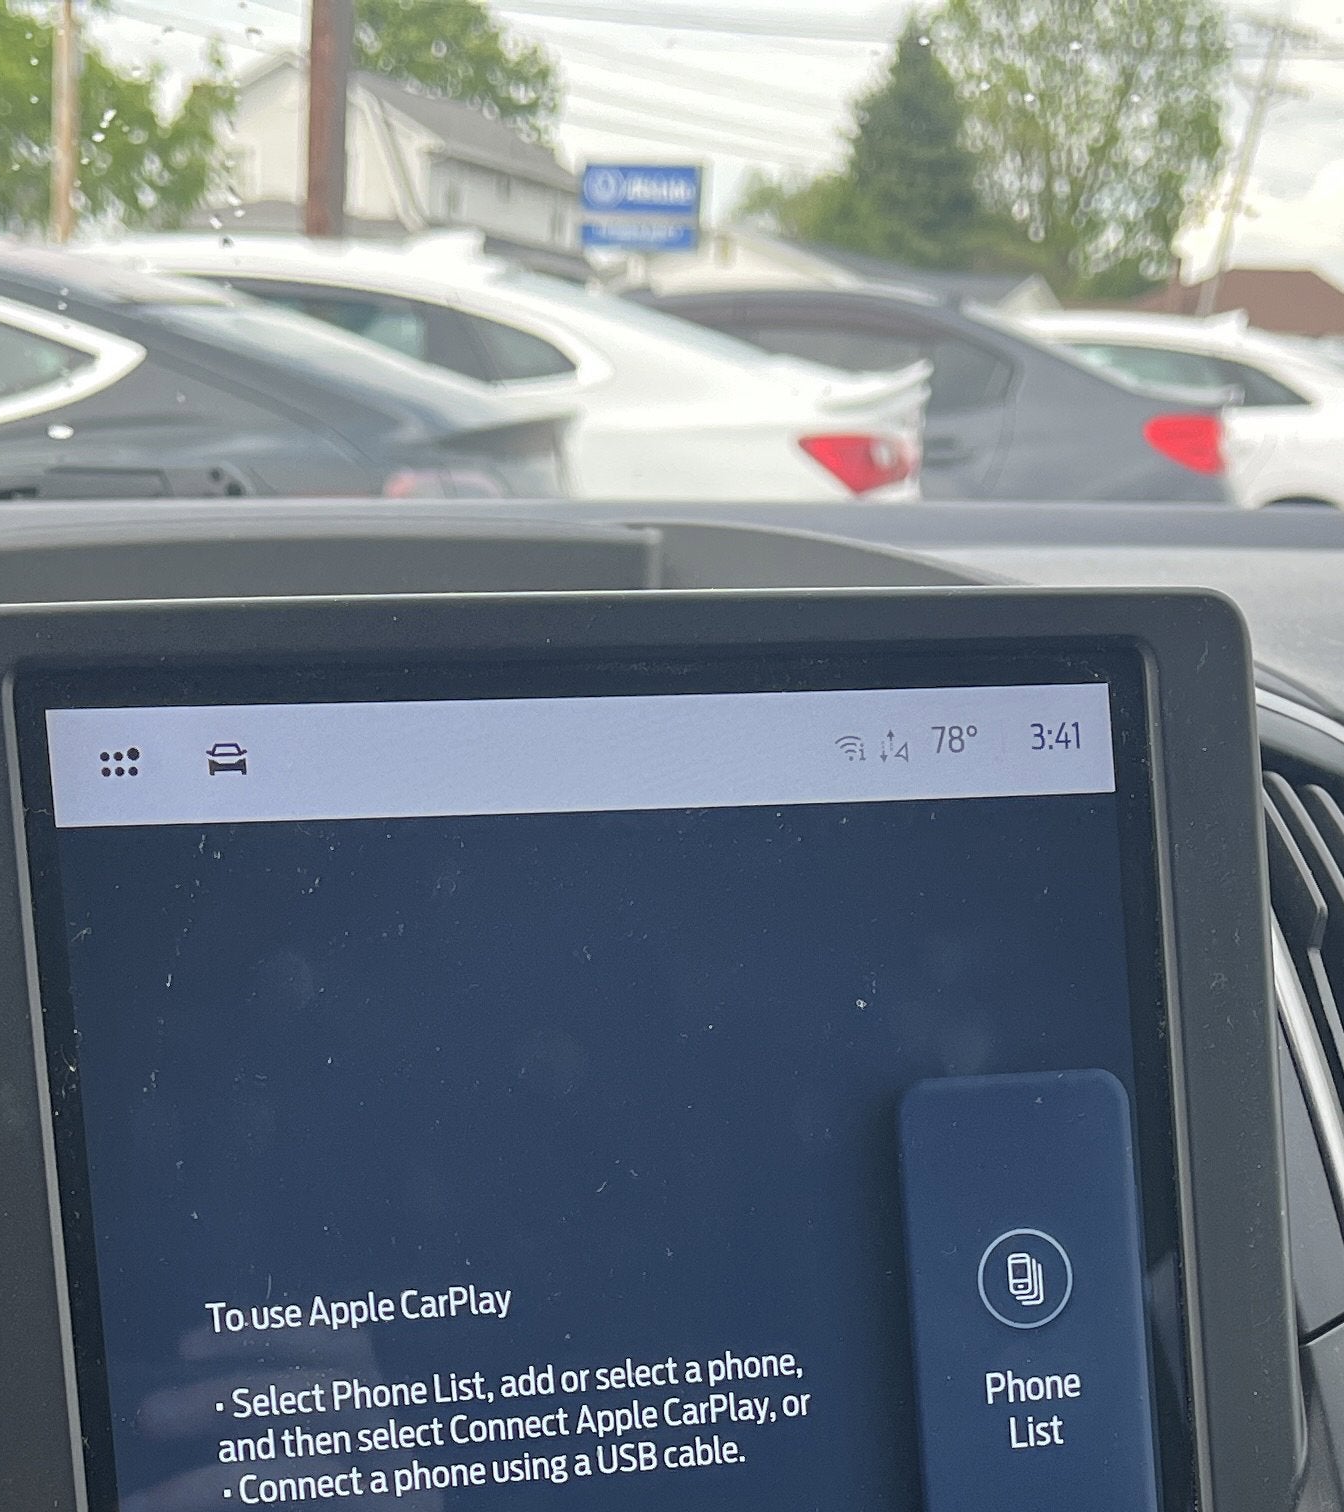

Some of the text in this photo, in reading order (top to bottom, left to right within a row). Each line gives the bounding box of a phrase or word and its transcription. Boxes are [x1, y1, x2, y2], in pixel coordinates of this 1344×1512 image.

[930, 724, 978, 754] 78°
[1030, 721, 1081, 751] 3:41
[204, 1284, 512, 1333] To use Apple CarPlay
[231, 1350, 803, 1418] Select Phone List, add or select a phone,
[985, 1370, 1081, 1405] Phone
[218, 1391, 811, 1463] and then select Connect Apple CarPlay, or
[1009, 1415, 1064, 1449] List
[239, 1434, 746, 1504] Connect a phone using a USB cable.
